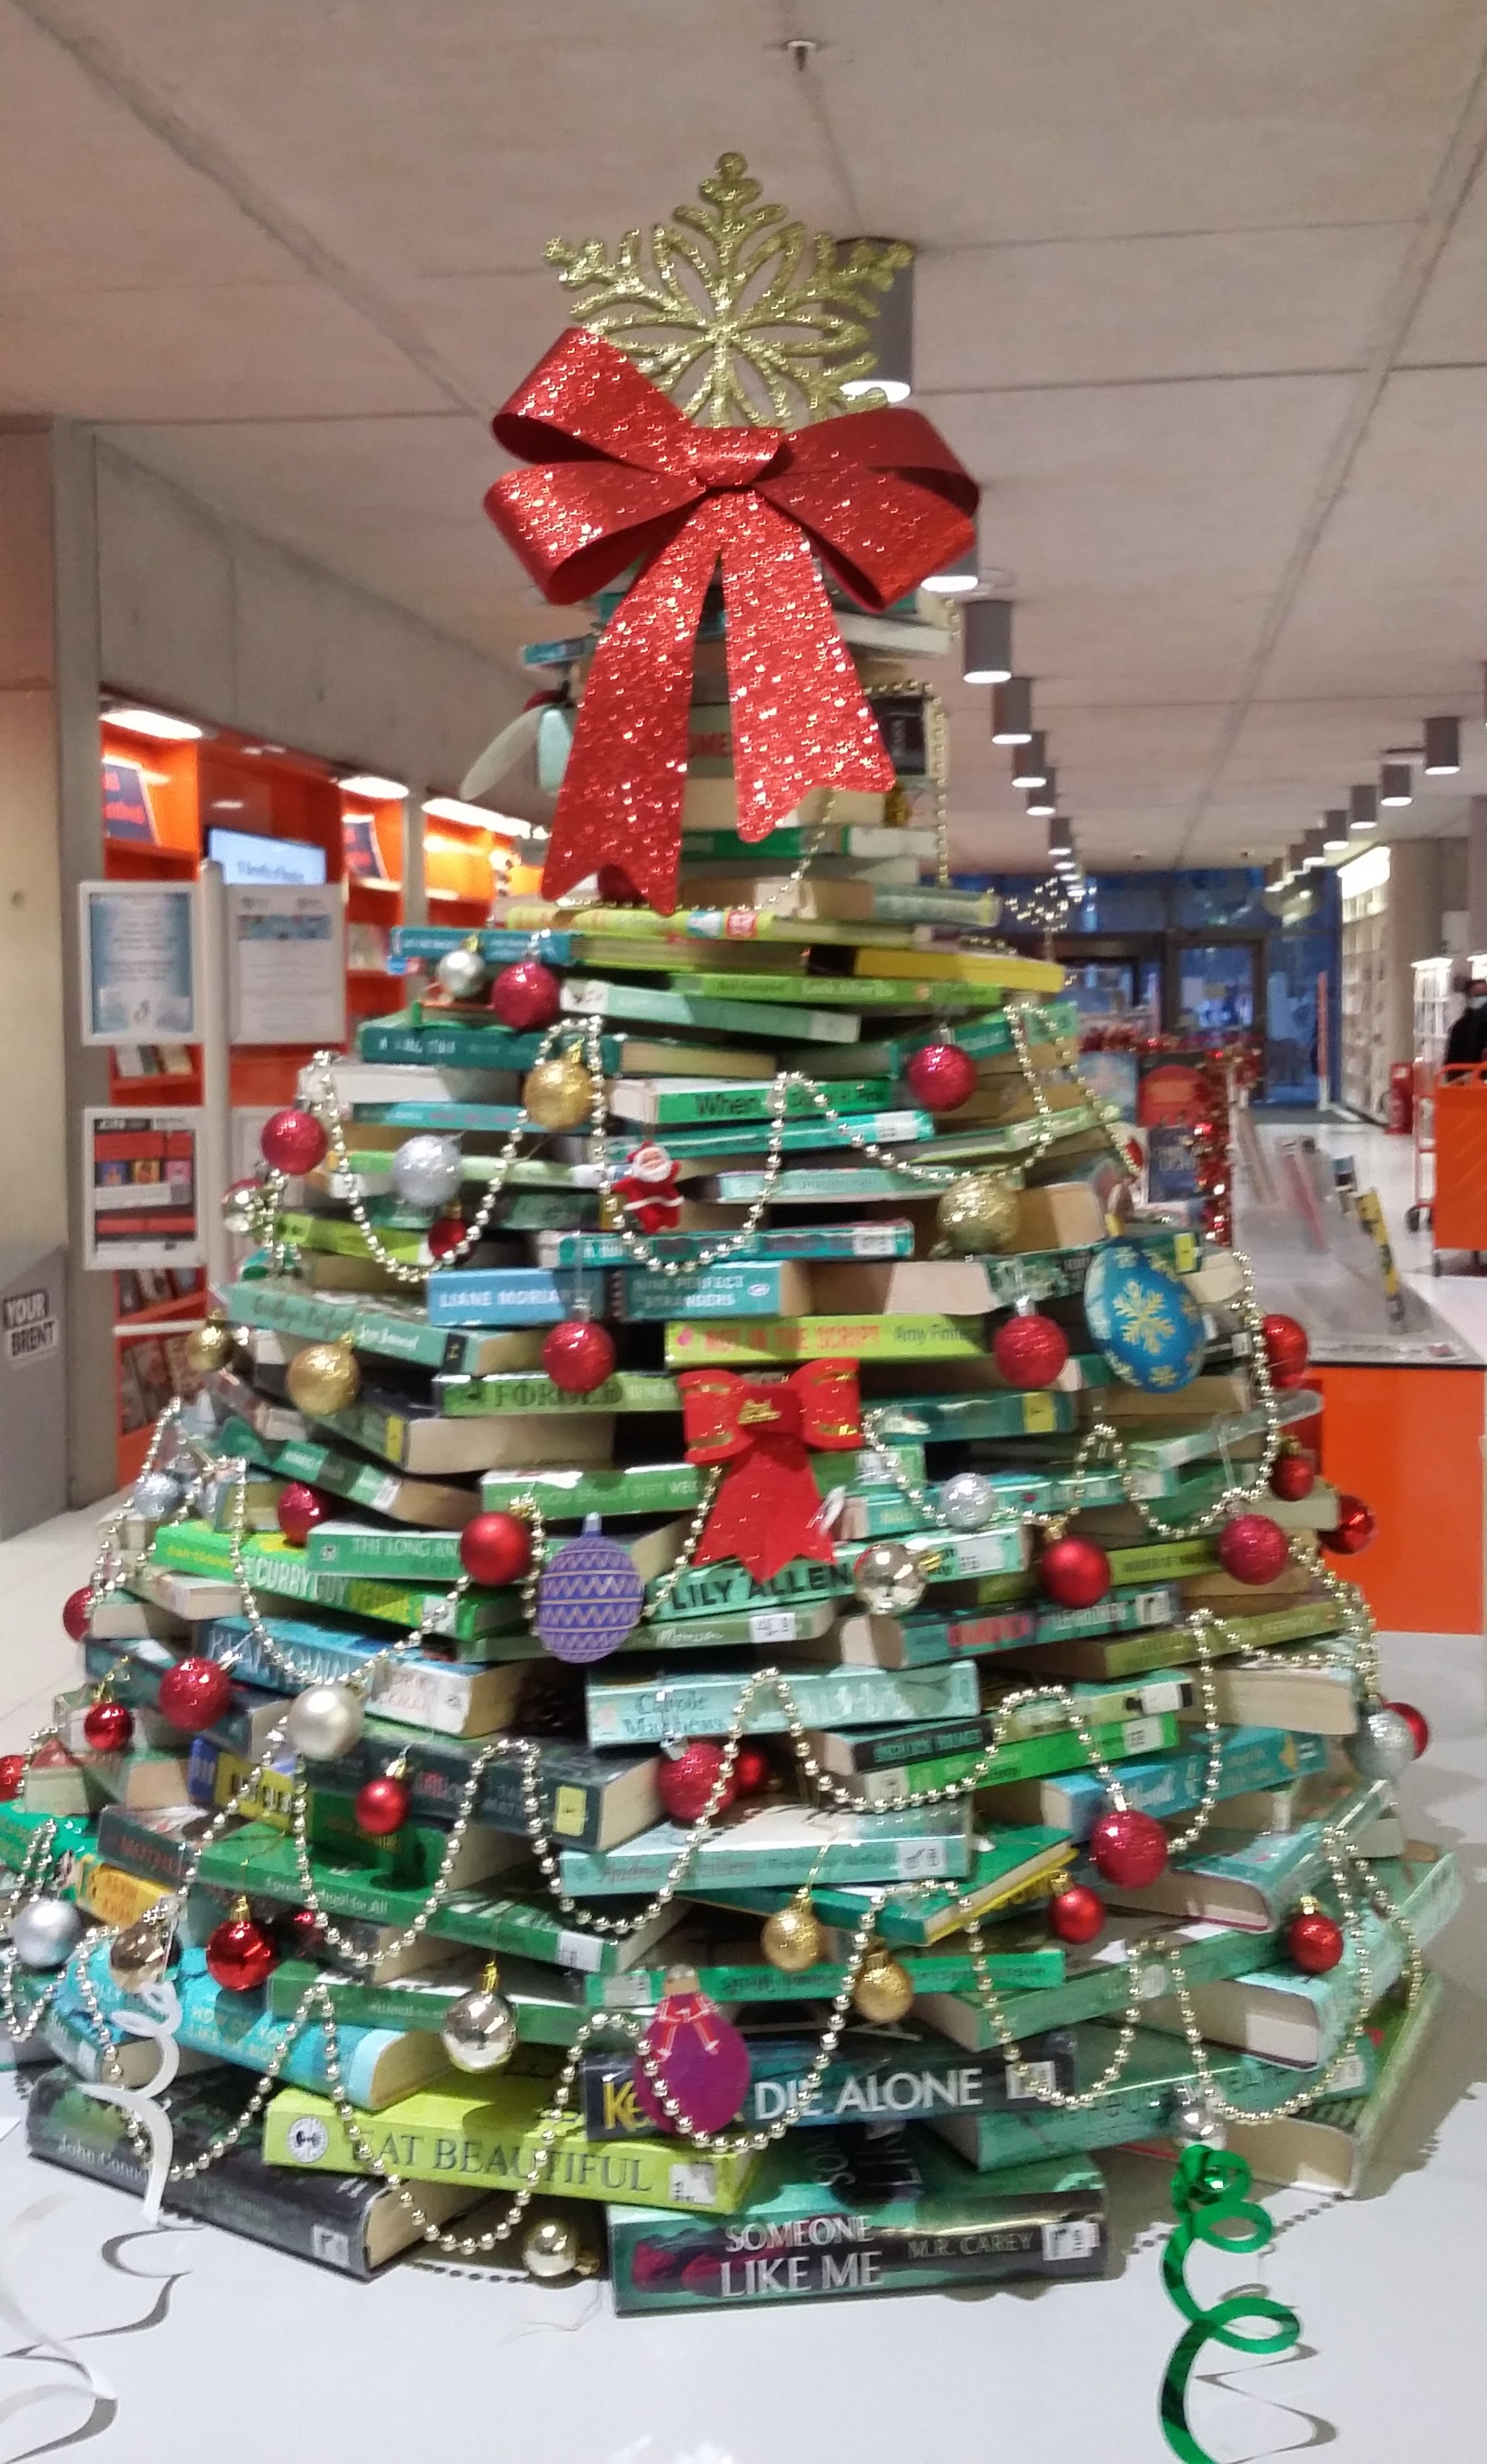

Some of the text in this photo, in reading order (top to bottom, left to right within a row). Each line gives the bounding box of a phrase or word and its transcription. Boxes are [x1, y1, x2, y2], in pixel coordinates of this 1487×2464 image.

[694, 1092, 762, 1117] When
[6, 1293, 46, 1326] YOUR
[438, 1290, 492, 1309] LIANE
[11, 1320, 55, 1356] BRENT
[816, 1324, 881, 1350] SCRIPT
[672, 1577, 732, 1611] LILY
[369, 1898, 389, 1916] All
[754, 2067, 984, 2121] DIE ALONE
[57, 2134, 96, 2163] John
[431, 2138, 654, 2194] BEAUTIFUL
[725, 2214, 875, 2253] SOMEONE
[960, 2232, 1033, 2257] CAREY
[720, 2249, 884, 2298] LIKE ME
